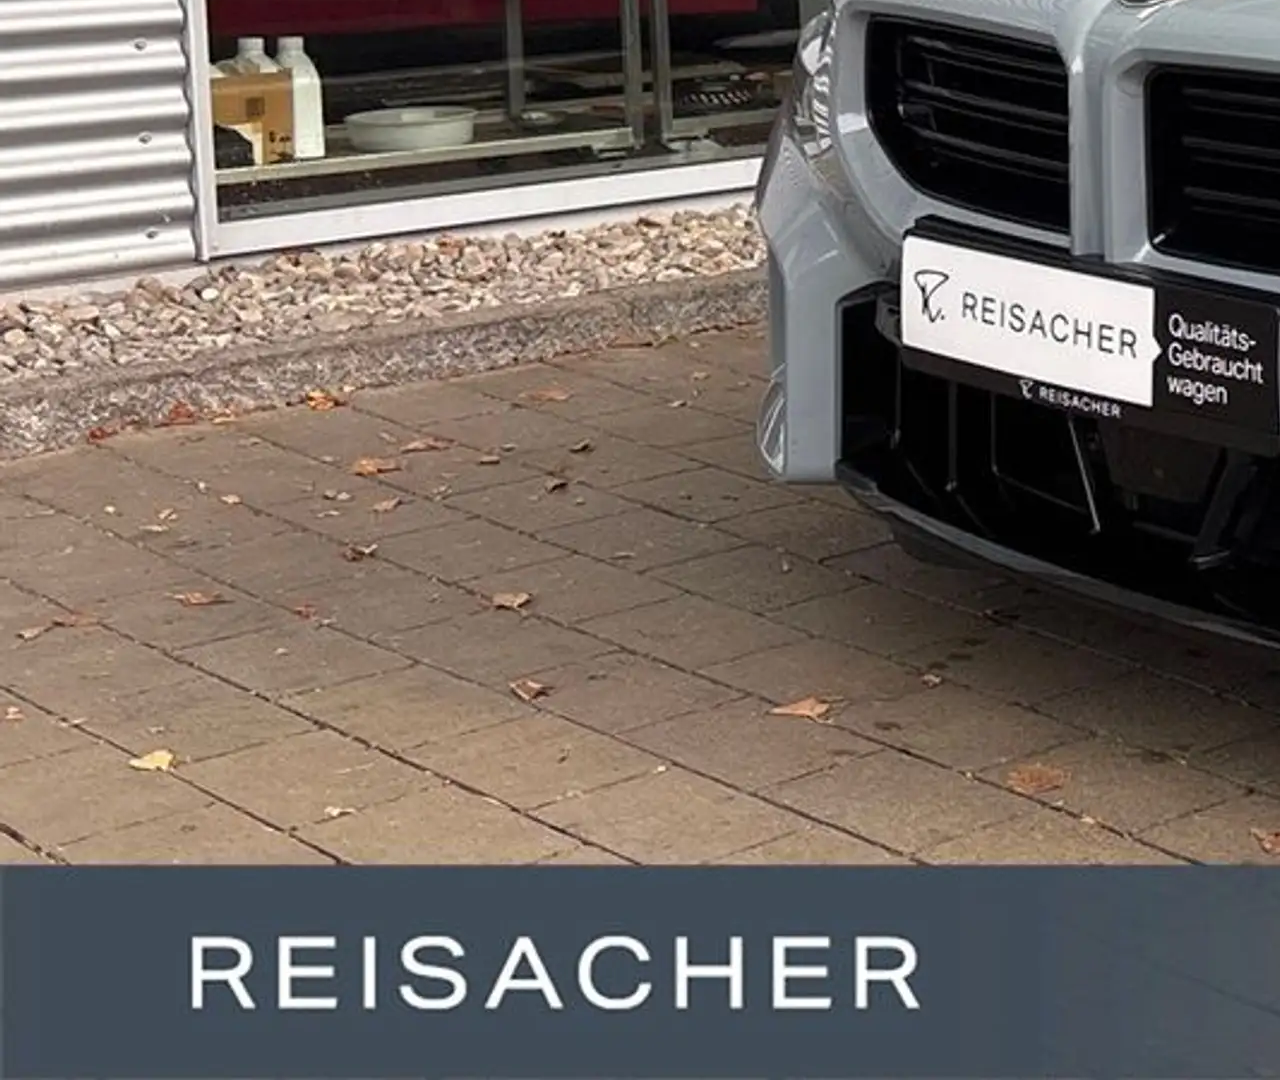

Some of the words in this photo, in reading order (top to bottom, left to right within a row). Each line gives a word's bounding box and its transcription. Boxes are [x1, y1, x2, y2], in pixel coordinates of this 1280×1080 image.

[961, 292, 1138, 359] REISACHER
[1168, 313, 1257, 352] Qualitäts-
[1168, 341, 1264, 384] Gebraucht
[1038, 386, 1122, 419] REISACHER
[1166, 375, 1228, 405] wagen
